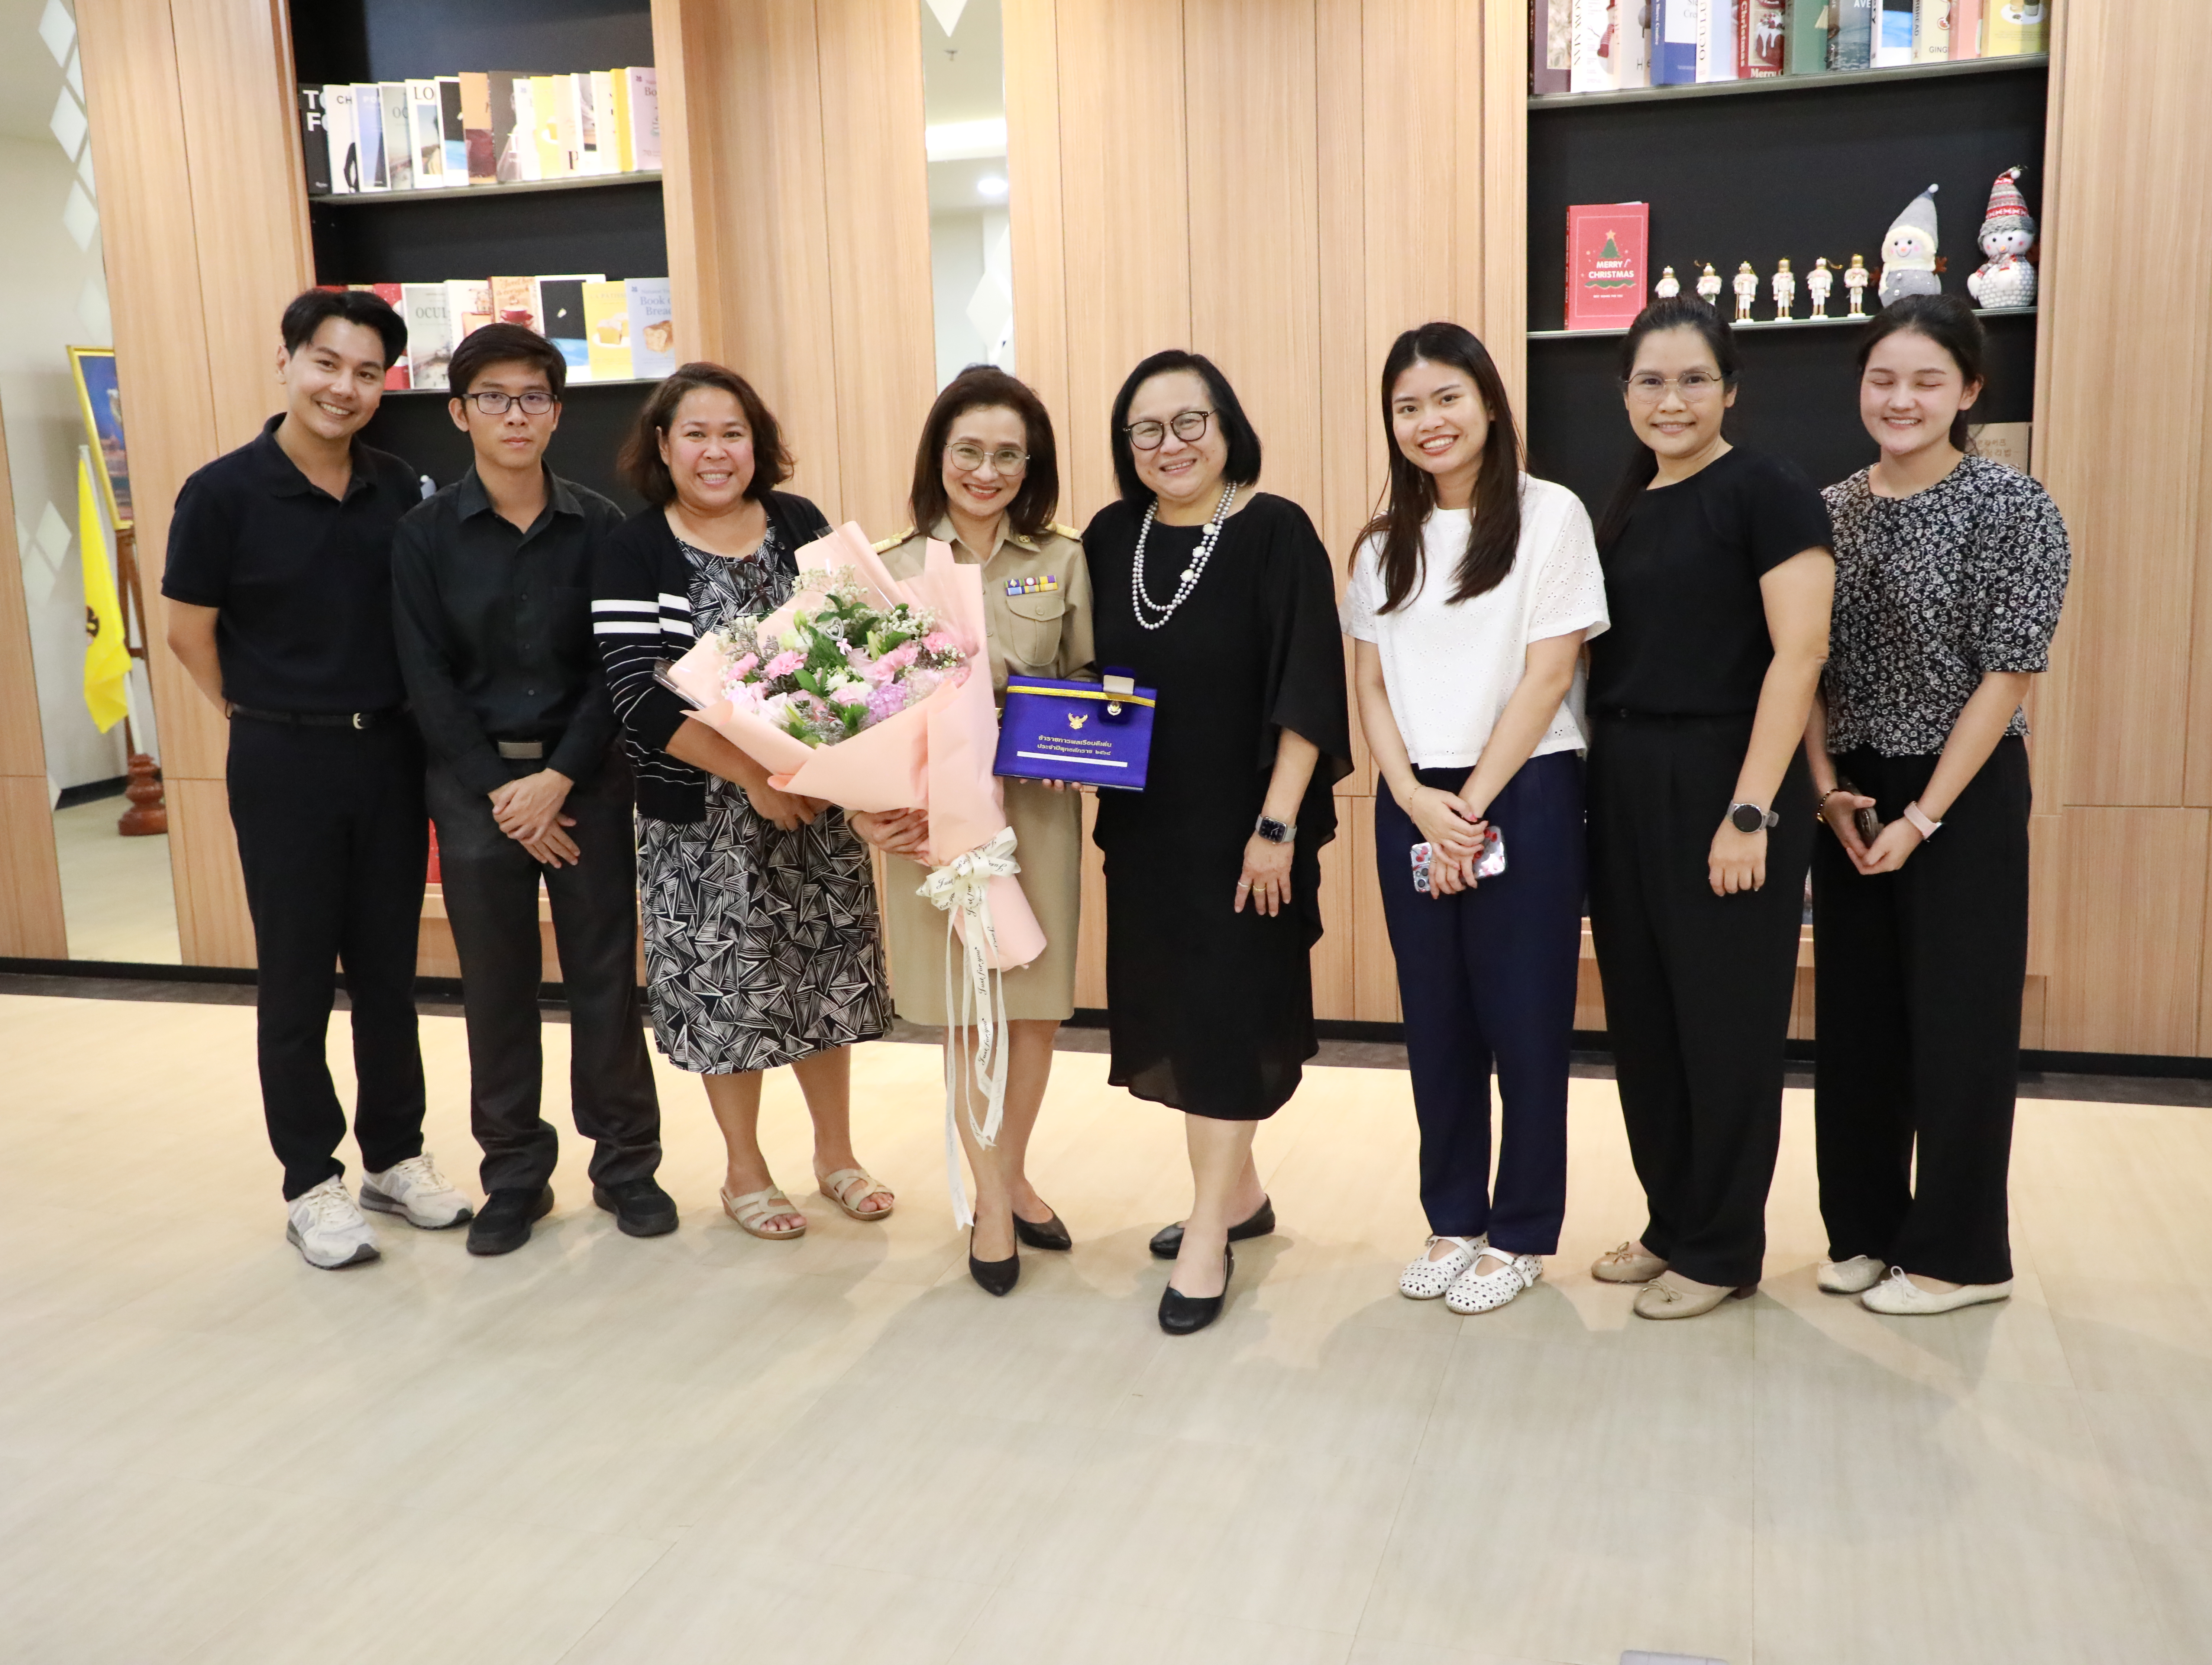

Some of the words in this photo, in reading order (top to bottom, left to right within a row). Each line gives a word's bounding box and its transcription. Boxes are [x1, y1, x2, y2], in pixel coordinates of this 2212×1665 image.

[337, 96, 352, 104] CH
[414, 87, 434, 100] LO
[1588, 270, 1634, 278] CHRISTMAS
[640, 295, 665, 305] Book
[1038, 734, 1112, 747] ข้าราชการพลเรือนดีเด่น
[936, 877, 954, 889] Just
[966, 898, 977, 917] Jst
[977, 964, 986, 979] for
[977, 977, 987, 995] Just
[977, 1048, 988, 1066] Just
